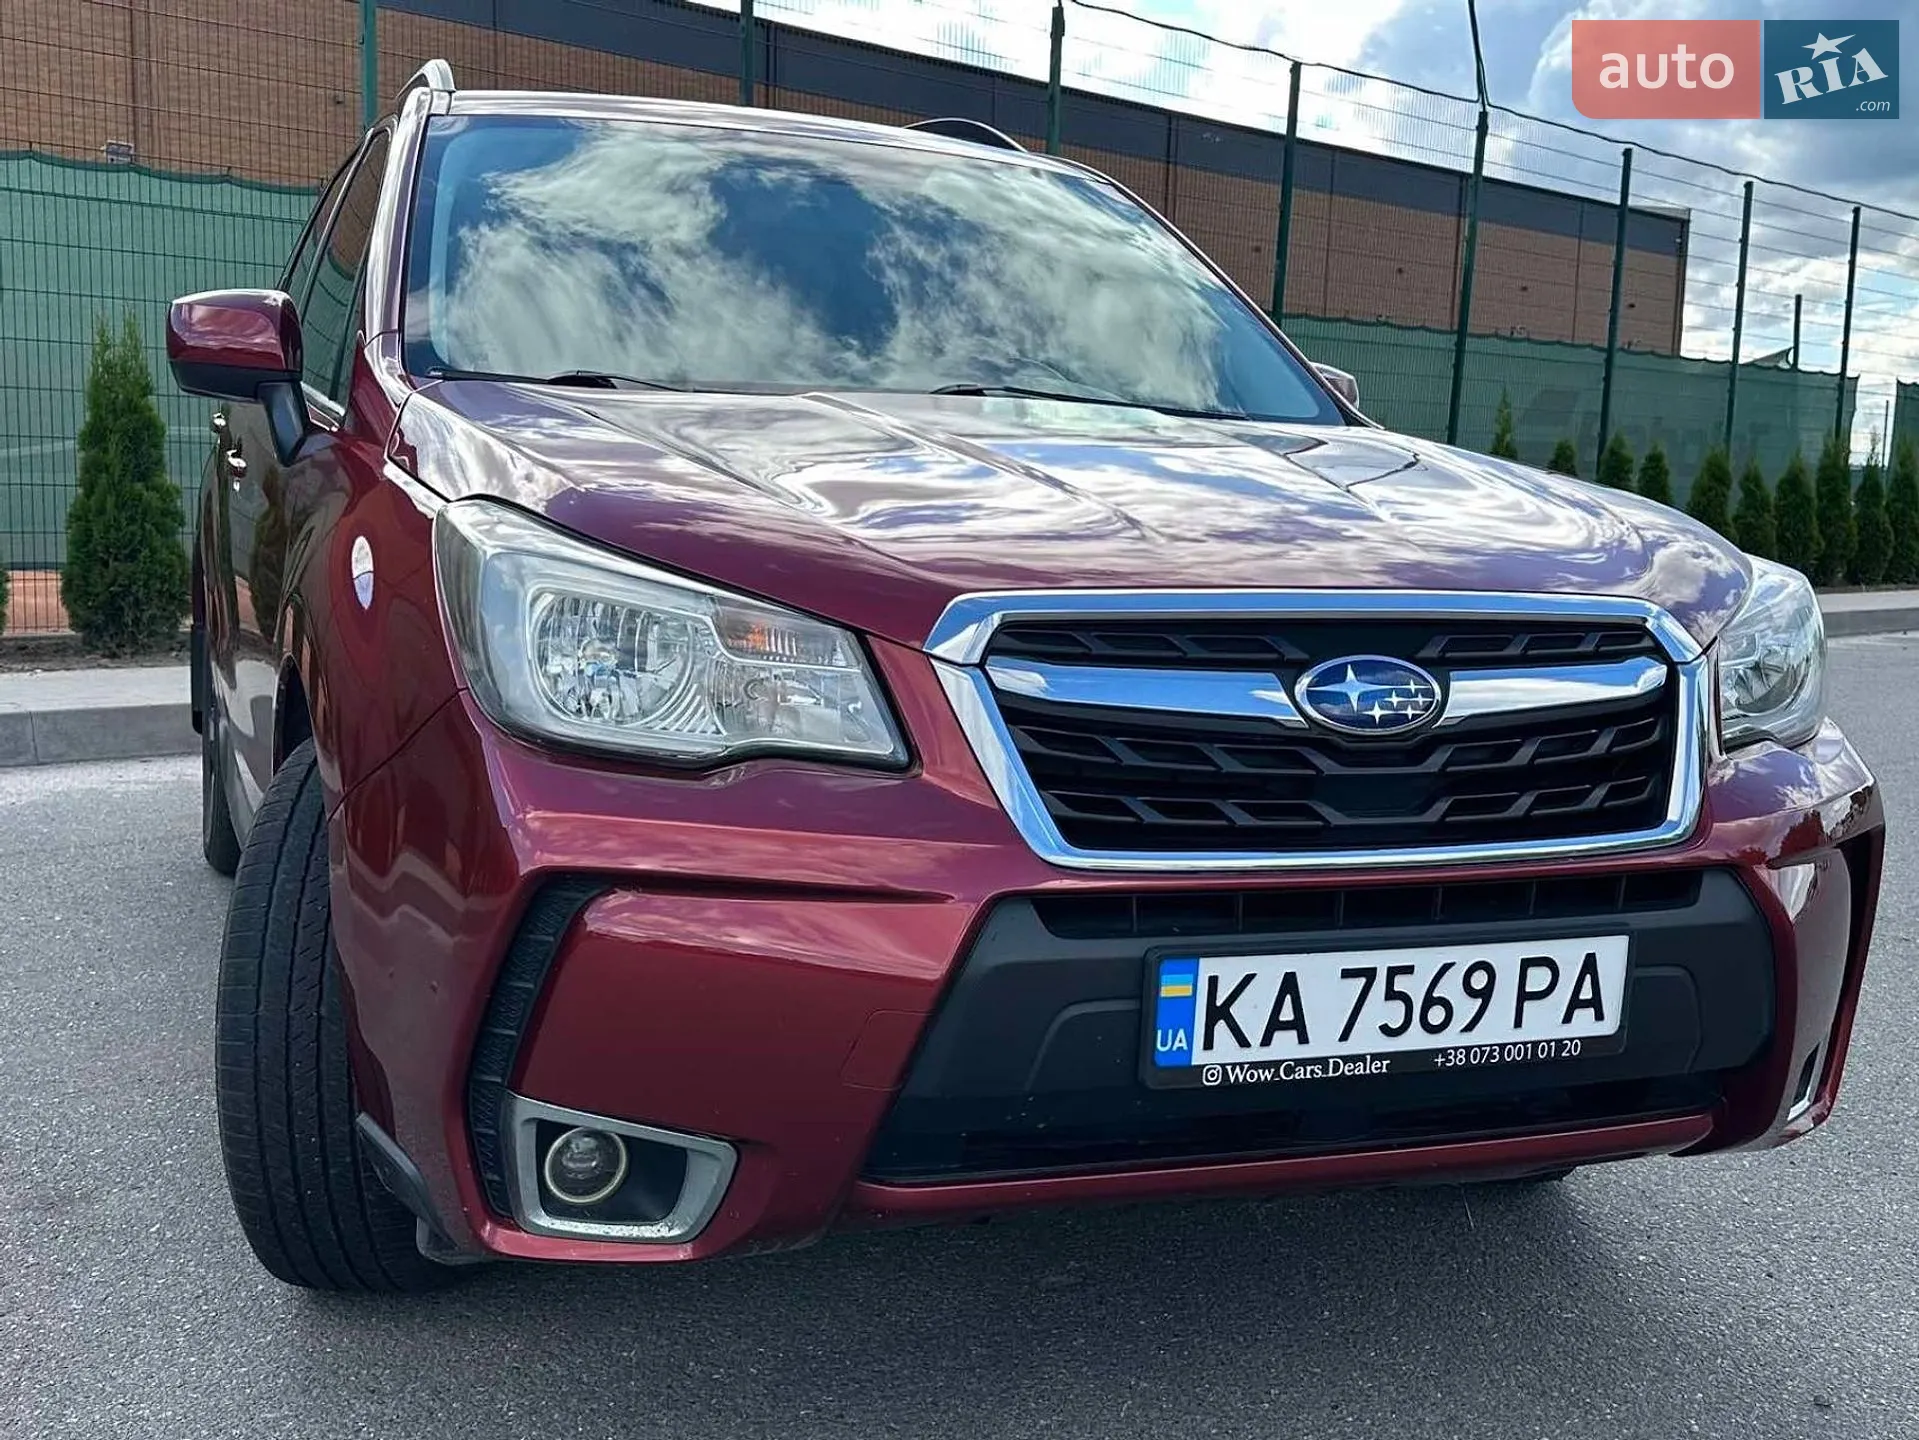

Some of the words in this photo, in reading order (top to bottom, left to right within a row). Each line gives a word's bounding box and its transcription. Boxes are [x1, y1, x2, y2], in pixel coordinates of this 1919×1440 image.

[1203, 971, 1310, 1051] KA
[1338, 960, 1497, 1042] 7569
[1513, 952, 1605, 1029] PA
[1156, 1028, 1188, 1052] UA
[1434, 1048, 1466, 1067] +38
[1470, 1046, 1500, 1064] 073
[1504, 1043, 1532, 1061] 001
[1538, 1041, 1556, 1059] 01
[1561, 1039, 1581, 1057] 20
